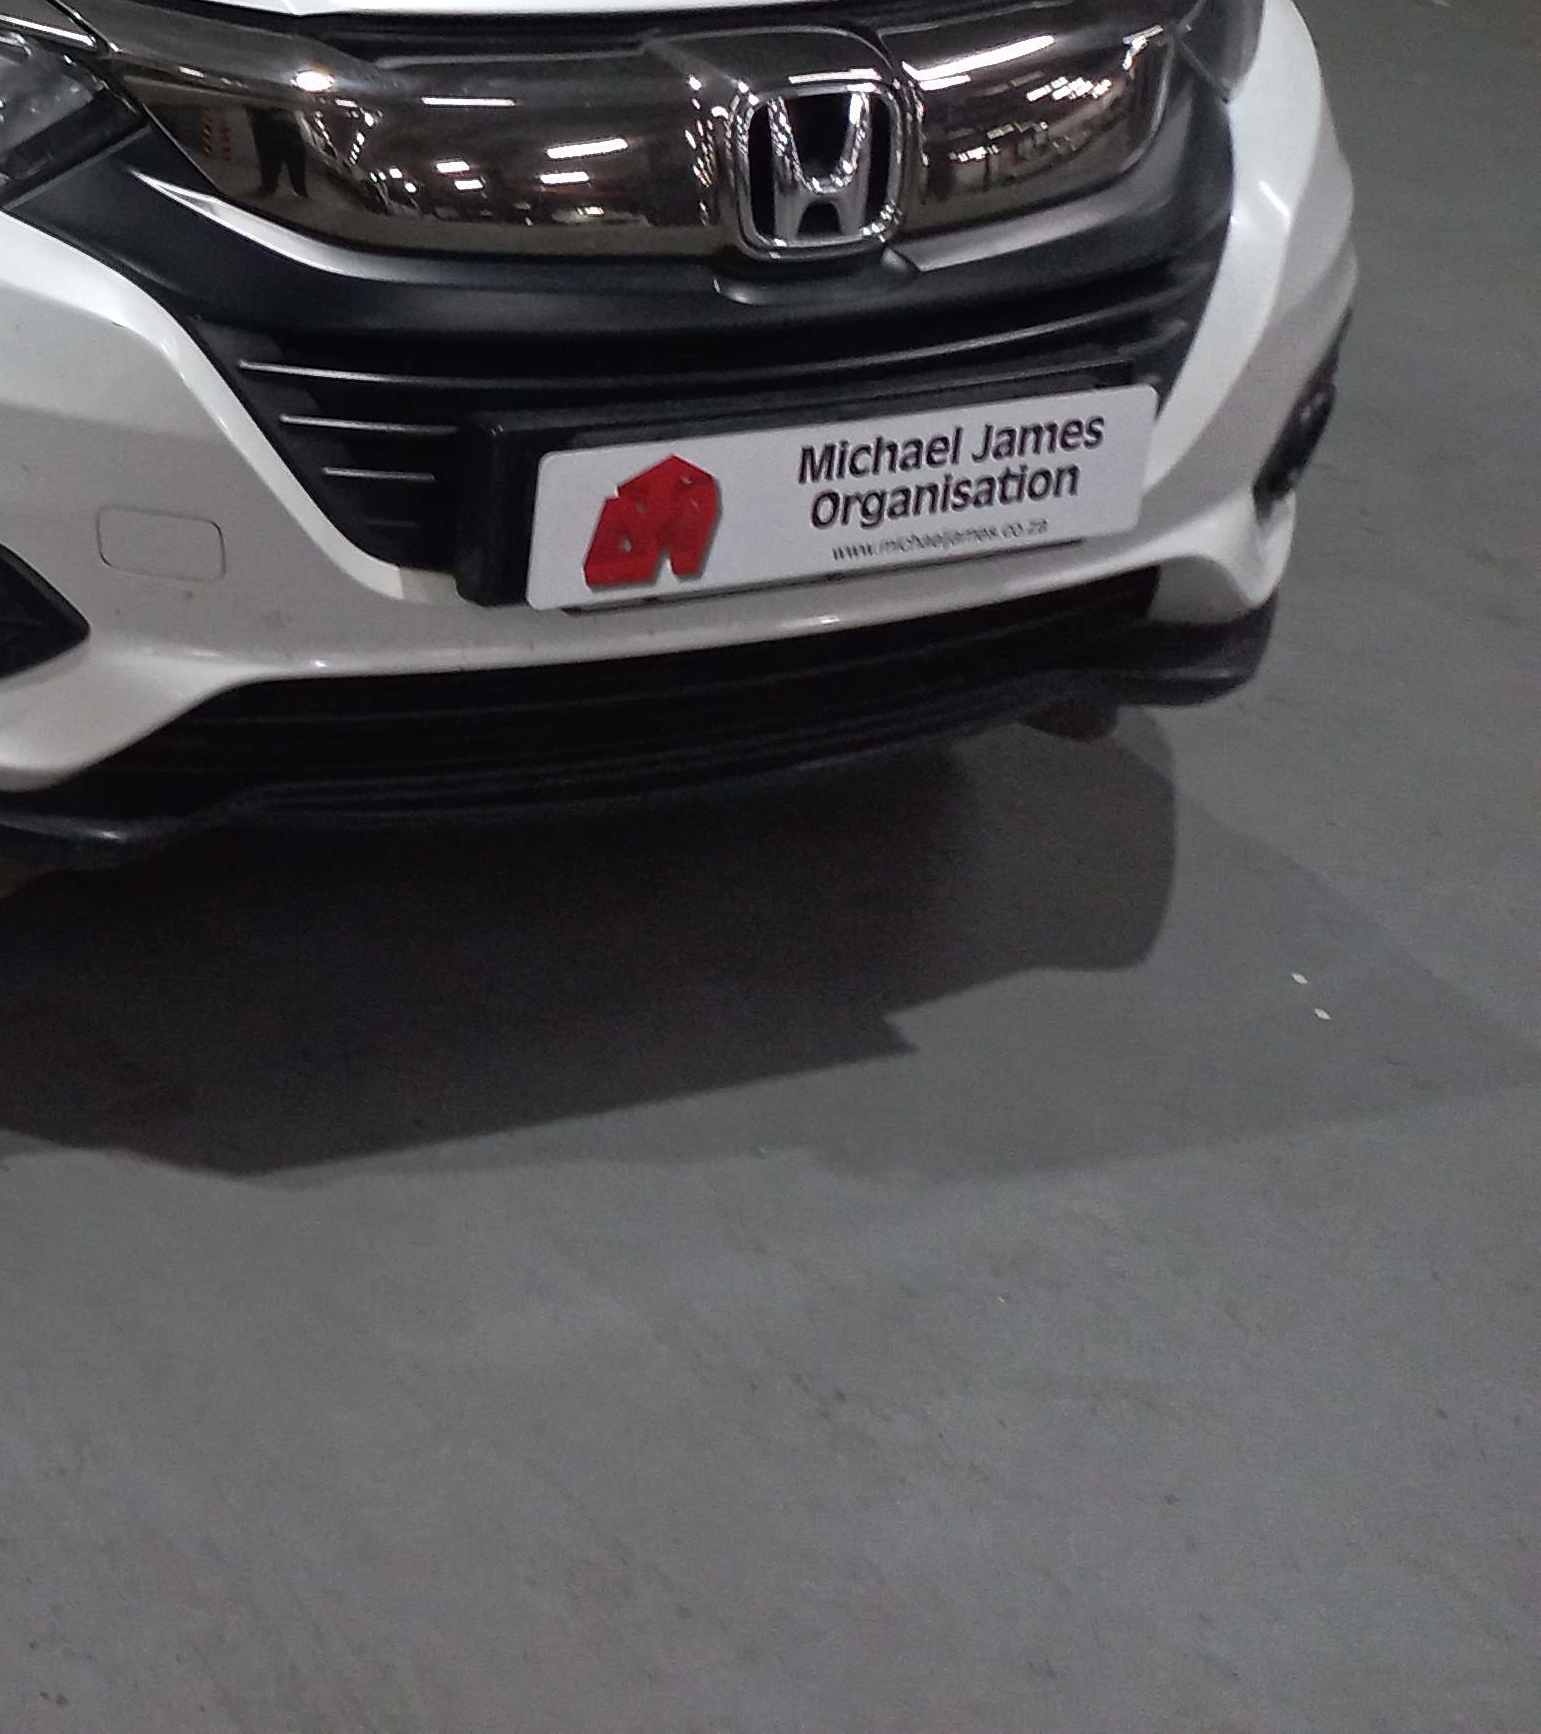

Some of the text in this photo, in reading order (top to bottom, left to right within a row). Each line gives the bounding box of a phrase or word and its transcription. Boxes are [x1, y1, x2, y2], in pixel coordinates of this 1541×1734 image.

[798, 416, 1105, 484] Michael James
[810, 463, 1080, 529] Organisation
